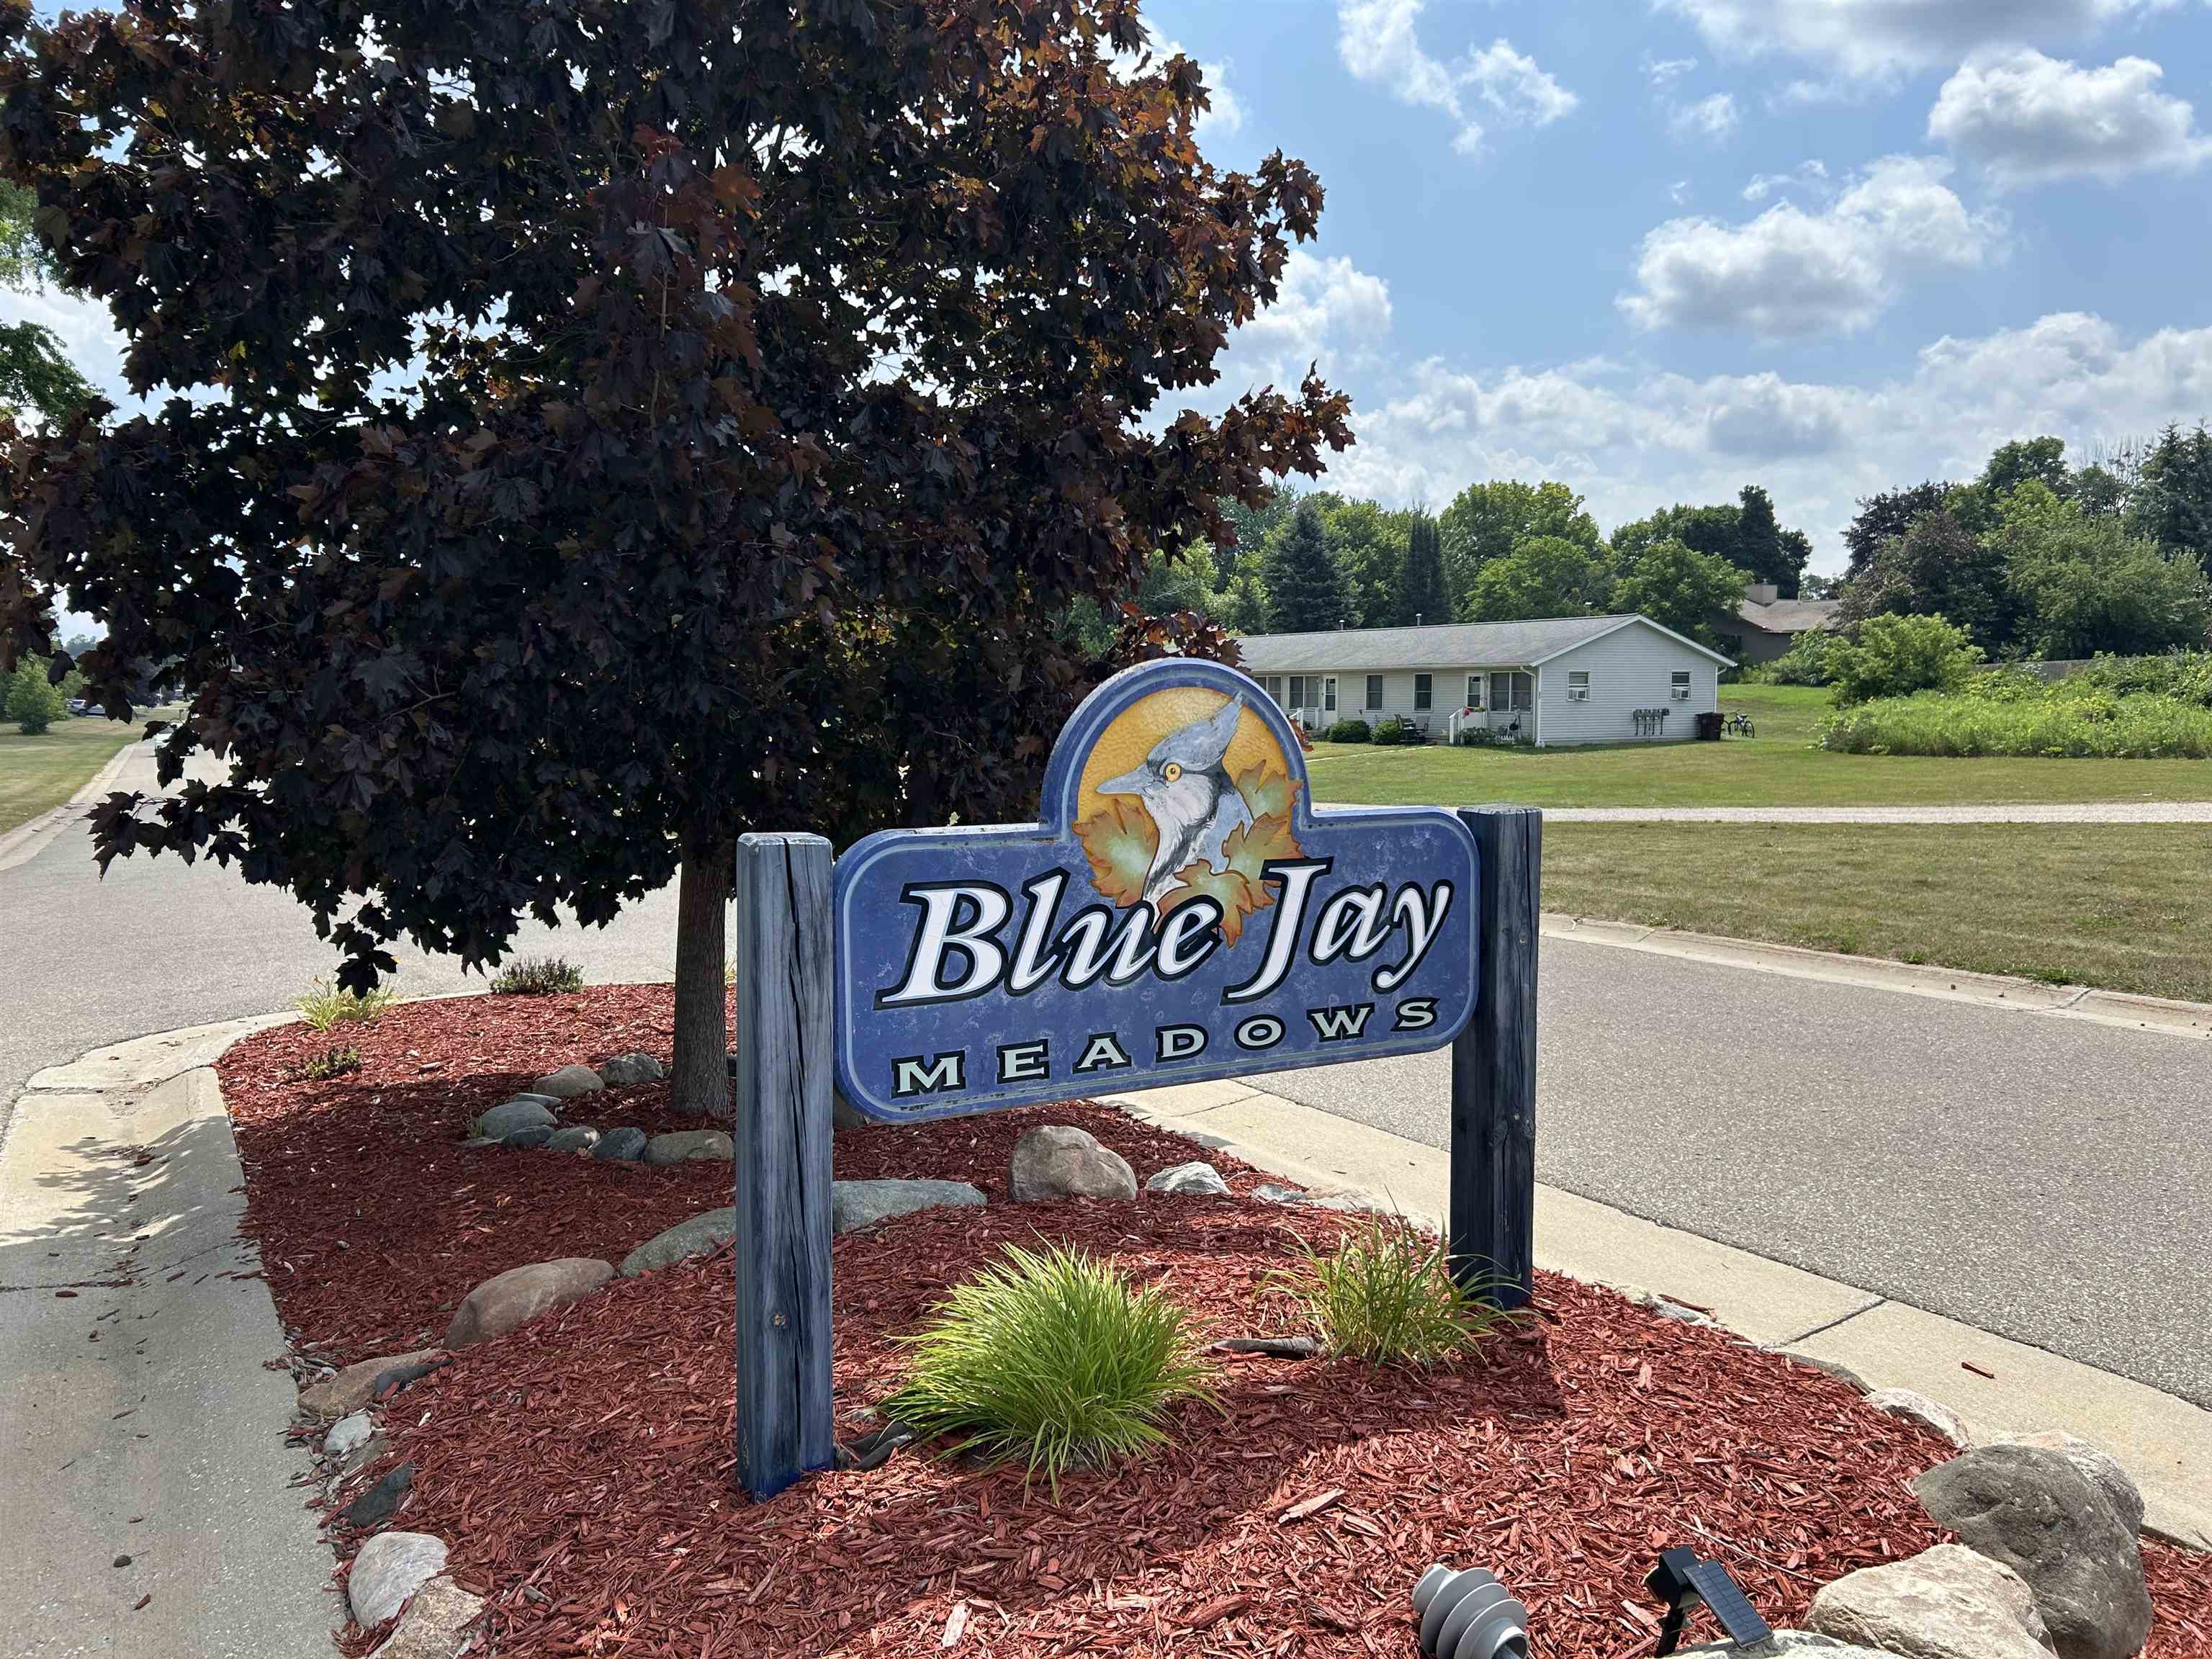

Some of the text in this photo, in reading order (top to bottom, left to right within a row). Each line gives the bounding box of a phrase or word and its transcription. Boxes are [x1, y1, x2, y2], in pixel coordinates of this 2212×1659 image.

[876, 858, 1454, 1008] Blue Jay
[892, 998, 1438, 1096] MEADOWS
